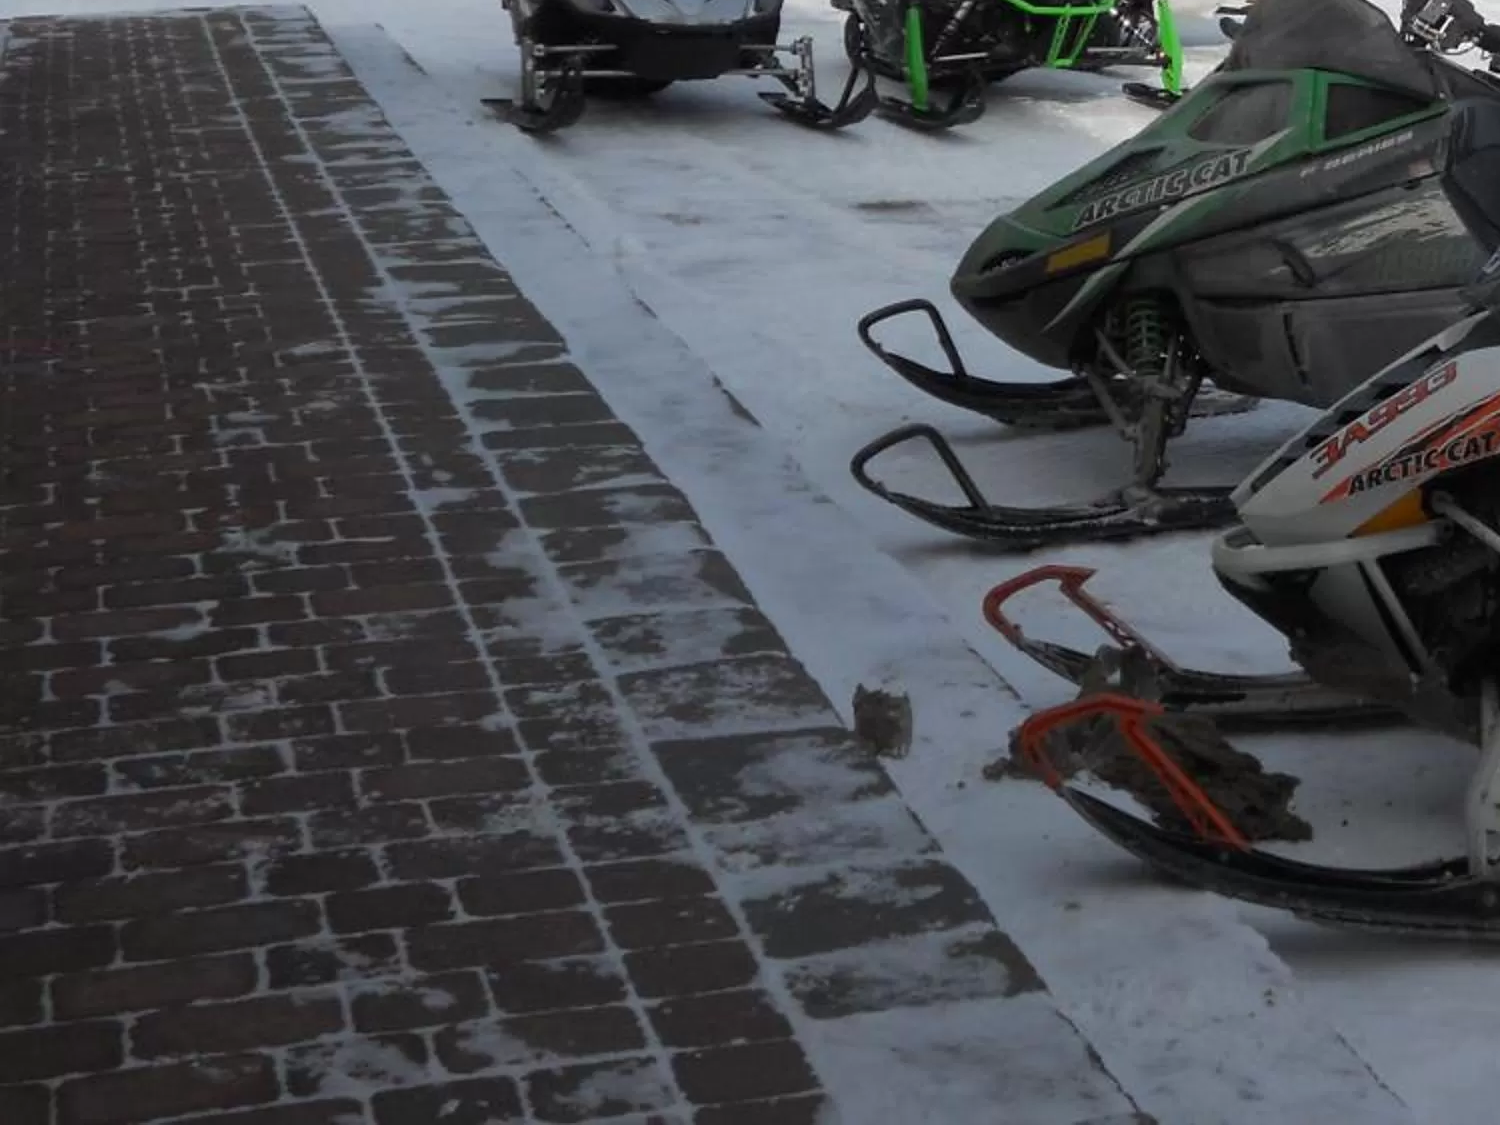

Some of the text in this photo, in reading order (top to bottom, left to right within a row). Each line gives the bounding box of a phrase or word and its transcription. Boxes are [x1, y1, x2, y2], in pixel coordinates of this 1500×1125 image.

[1073, 166, 1191, 228] ARCTIC
[1190, 148, 1254, 191] CAT
[1348, 430, 1498, 497] ARCTIC CAT
